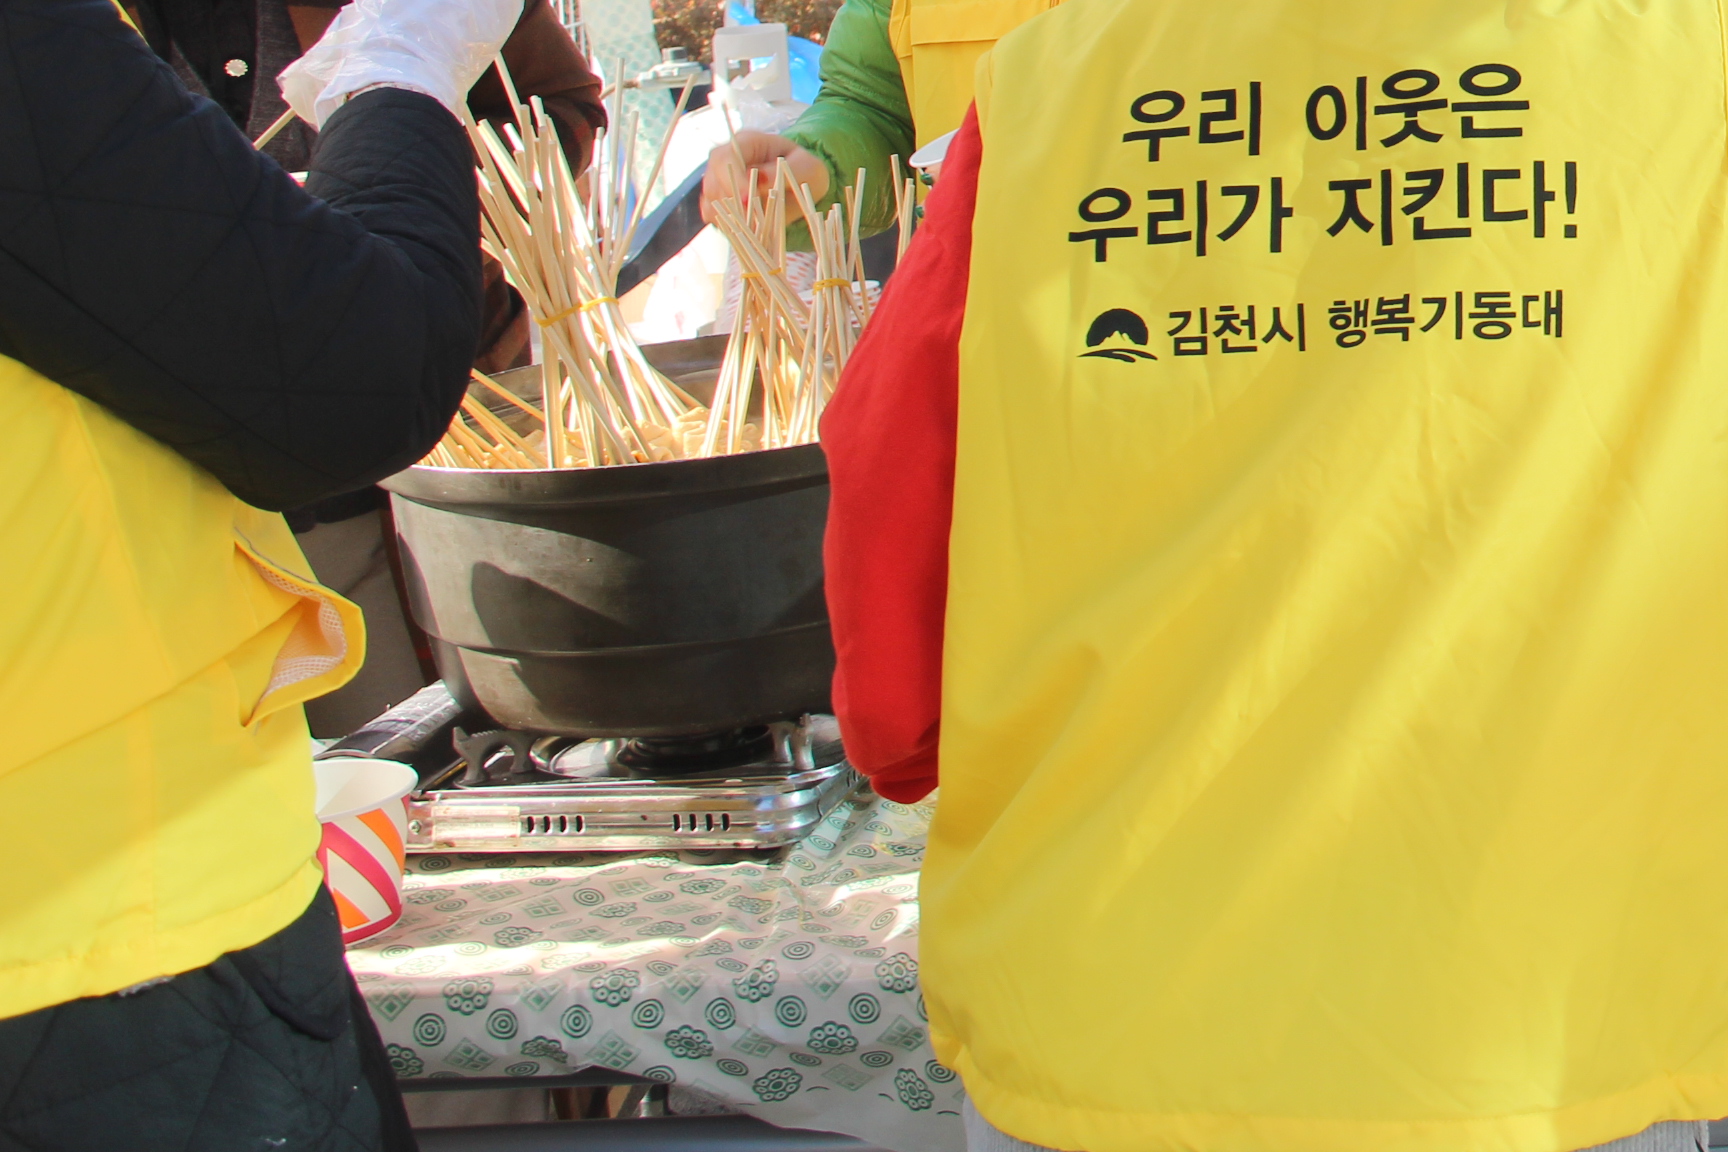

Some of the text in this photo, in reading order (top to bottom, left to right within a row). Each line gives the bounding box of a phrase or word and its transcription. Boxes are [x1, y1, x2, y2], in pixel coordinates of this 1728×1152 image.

[1123, 64, 1529, 162] 우리 이웃은
[1069, 161, 1576, 262] 우리가 지킨다!
[1168, 291, 1562, 355] 김천시 행복기동대
